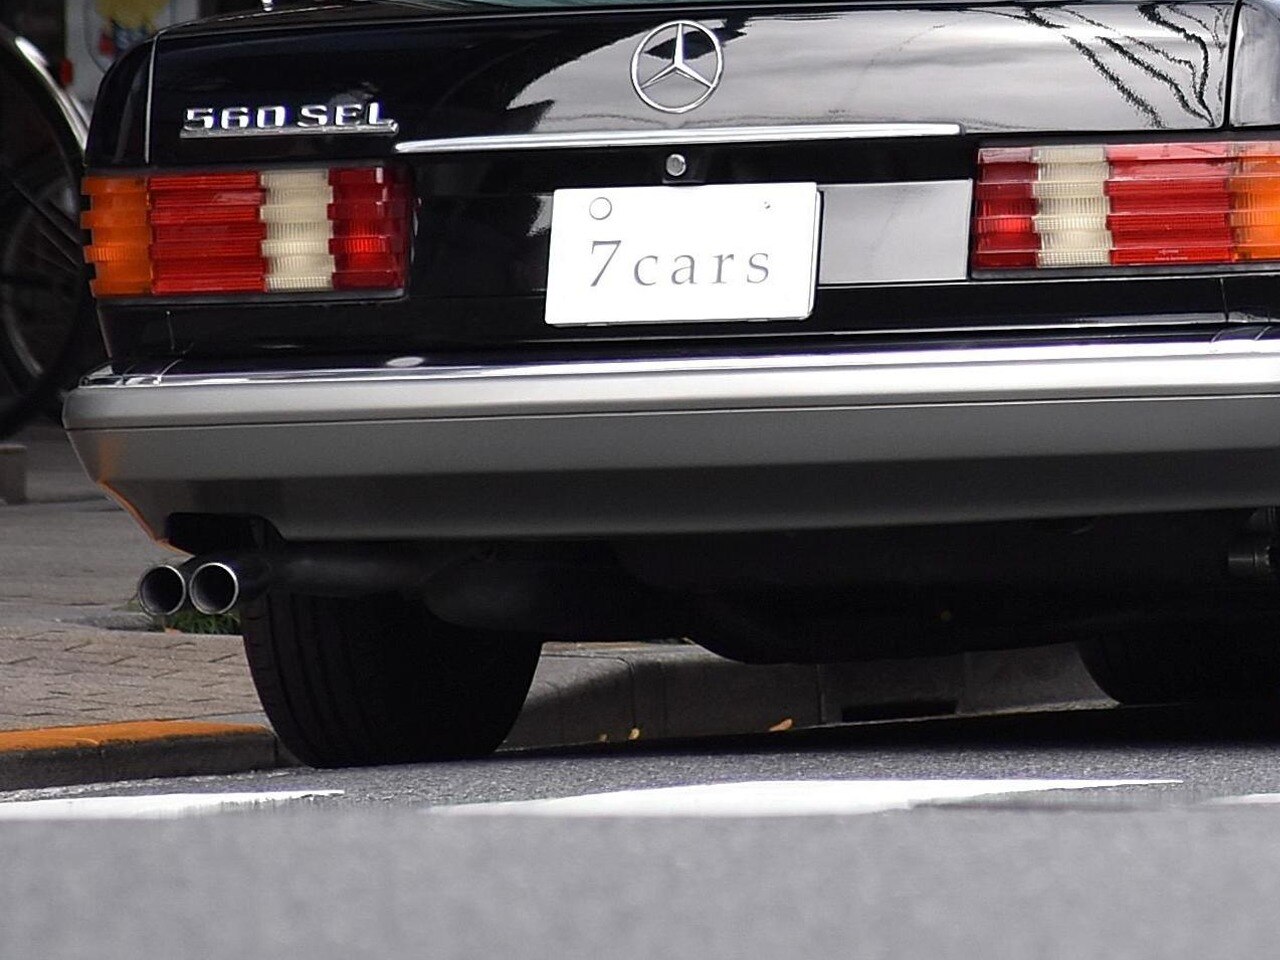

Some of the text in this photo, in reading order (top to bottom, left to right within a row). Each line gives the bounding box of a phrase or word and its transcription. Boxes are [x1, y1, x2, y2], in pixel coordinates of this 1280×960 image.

[184, 102, 397, 131] 560 SEL
[590, 239, 770, 288] 7cars
